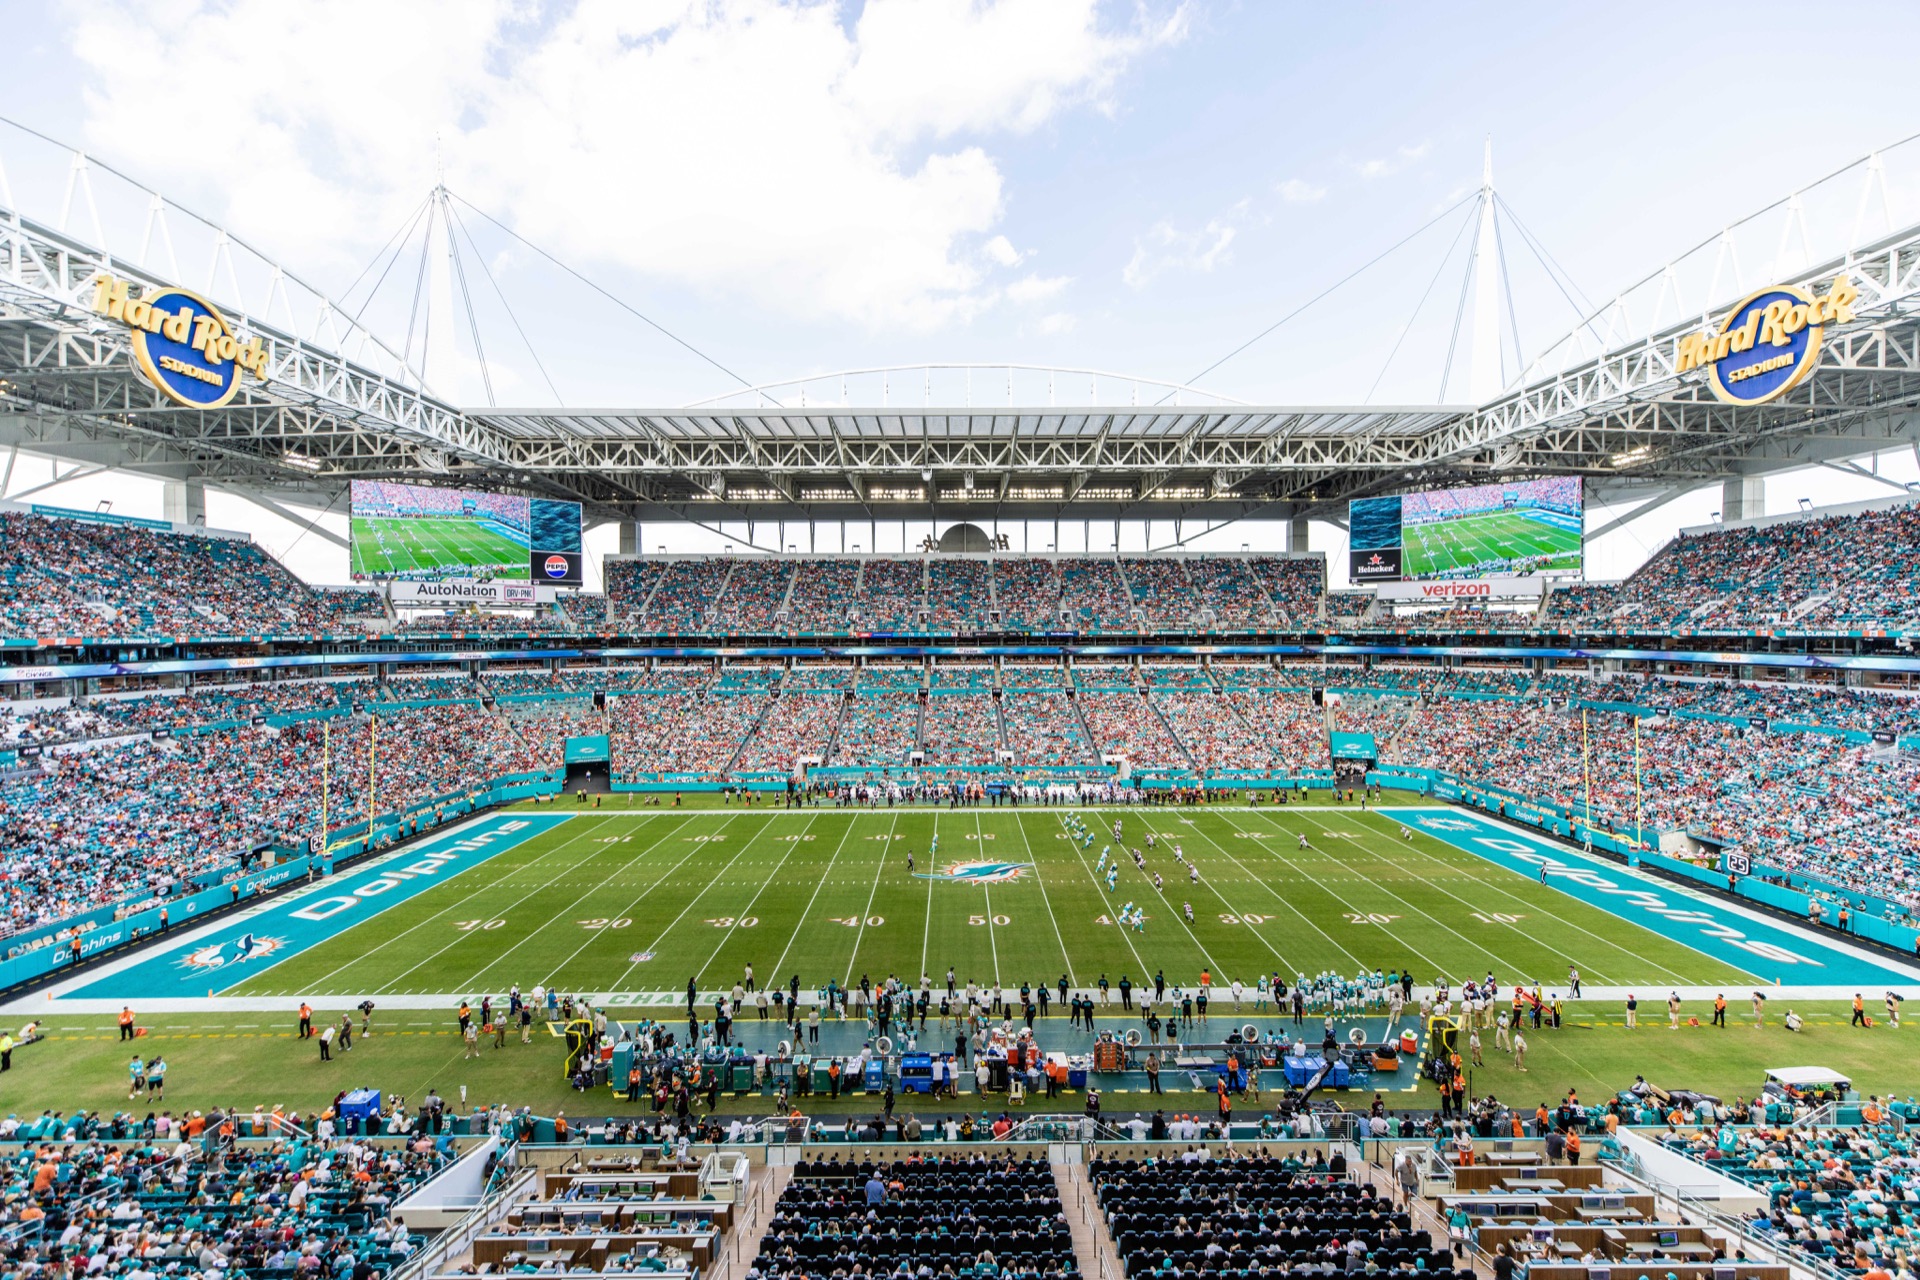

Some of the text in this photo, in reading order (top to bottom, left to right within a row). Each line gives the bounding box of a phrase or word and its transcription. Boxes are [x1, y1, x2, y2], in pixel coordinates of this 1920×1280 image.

[93, 275, 270, 382] Hard Rock
[1675, 275, 1859, 374] Hard Rock
[159, 355, 223, 387] STADIUM
[1728, 352, 1795, 384] STADIUM
[417, 583, 497, 597] AutoNation
[1422, 582, 1491, 596] verizon
[313, 837, 324, 849] 25
[1731, 857, 1745, 870] 25
[288, 820, 530, 921] Dolphins
[1471, 837, 1827, 968] Dolphins
[583, 918, 632, 929] 20
[713, 917, 759, 927] 30
[841, 916, 884, 926] 40
[968, 915, 1011, 926] 50
[1218, 913, 1264, 924] 30
[1342, 912, 1390, 924] 20
[1469, 912, 1517, 924] 10
[457, 919, 506, 930] 10
[53, 931, 121, 965] Dophins
[1780, 1105, 1790, 1114] 13
[347, 1121, 352, 1129] 2
[1723, 1134, 1733, 1144] 17
